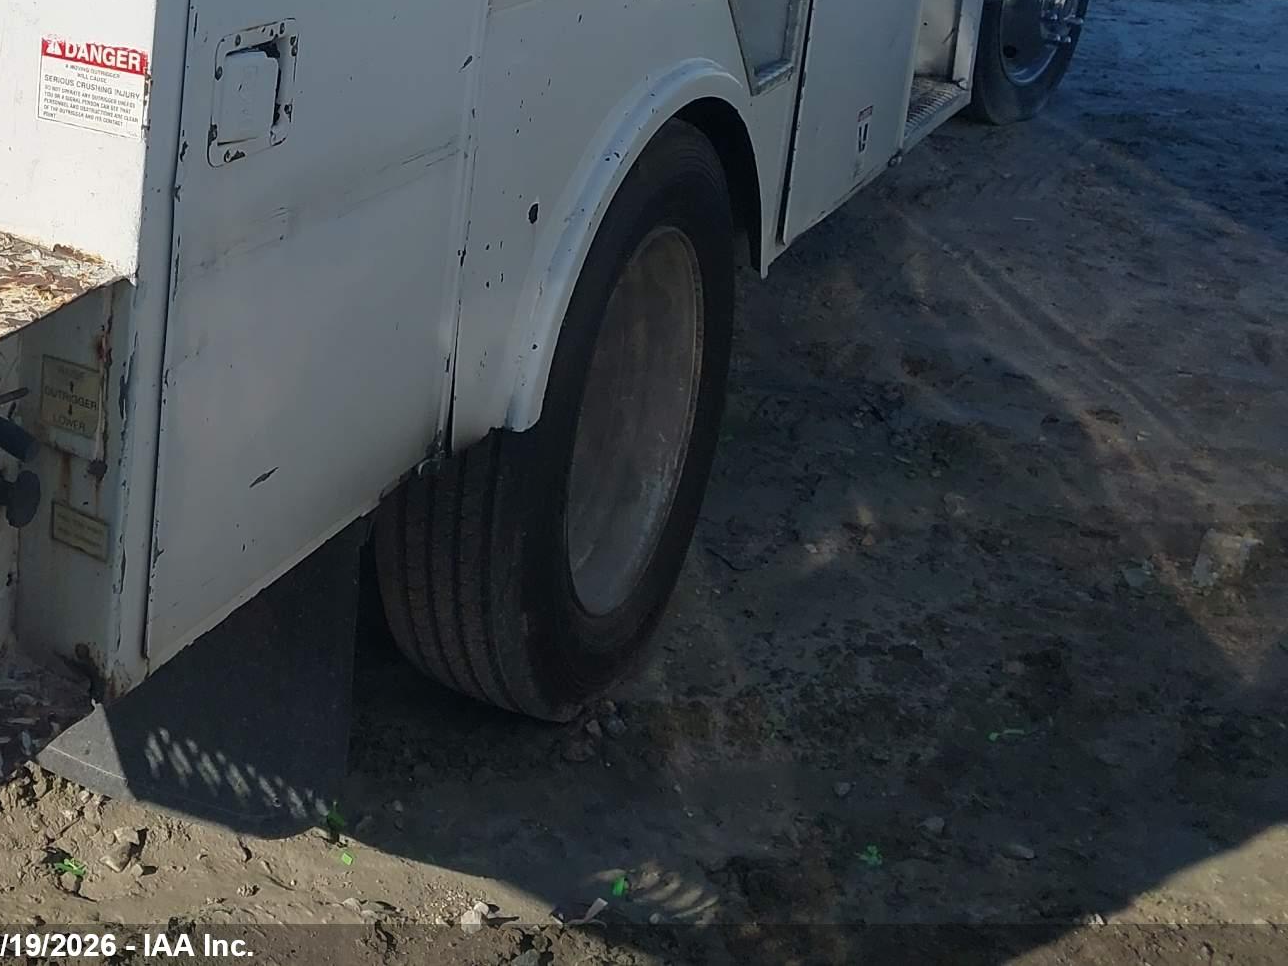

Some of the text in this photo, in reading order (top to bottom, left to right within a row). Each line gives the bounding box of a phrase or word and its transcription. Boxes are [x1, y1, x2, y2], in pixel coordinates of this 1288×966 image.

[65, 40, 141, 72] DANGER
[44, 74, 74, 86] SERIOUS
[76, 81, 112, 94] CRUSHING
[45, 385, 97, 410] OUTRIGGER
